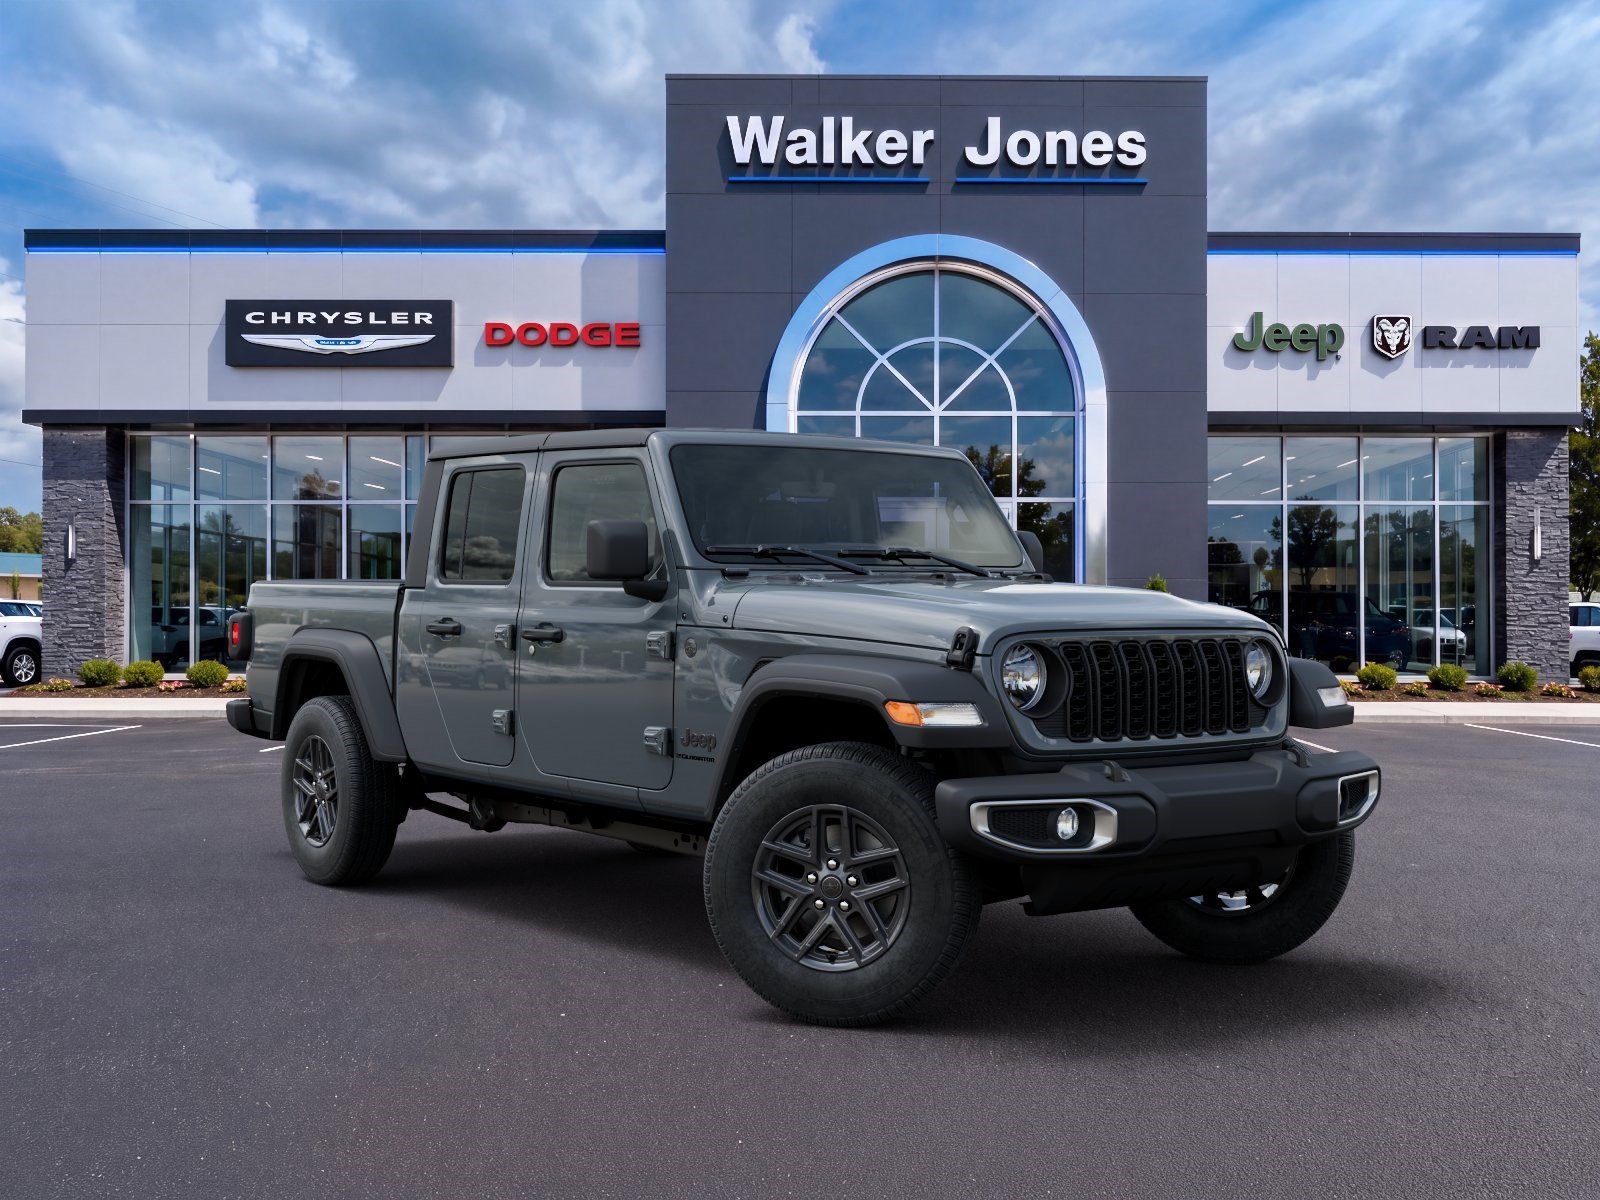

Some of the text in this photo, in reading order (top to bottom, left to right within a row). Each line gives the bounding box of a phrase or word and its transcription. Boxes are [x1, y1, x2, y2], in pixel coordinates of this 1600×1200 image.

[726, 115, 1148, 167] Walker Jones
[245, 311, 433, 325] CHRYSLER
[484, 322, 641, 347] DODGE
[1233, 311, 1345, 361] Jeep
[1422, 325, 1541, 348] RAM
[680, 727, 717, 753] Jeep
